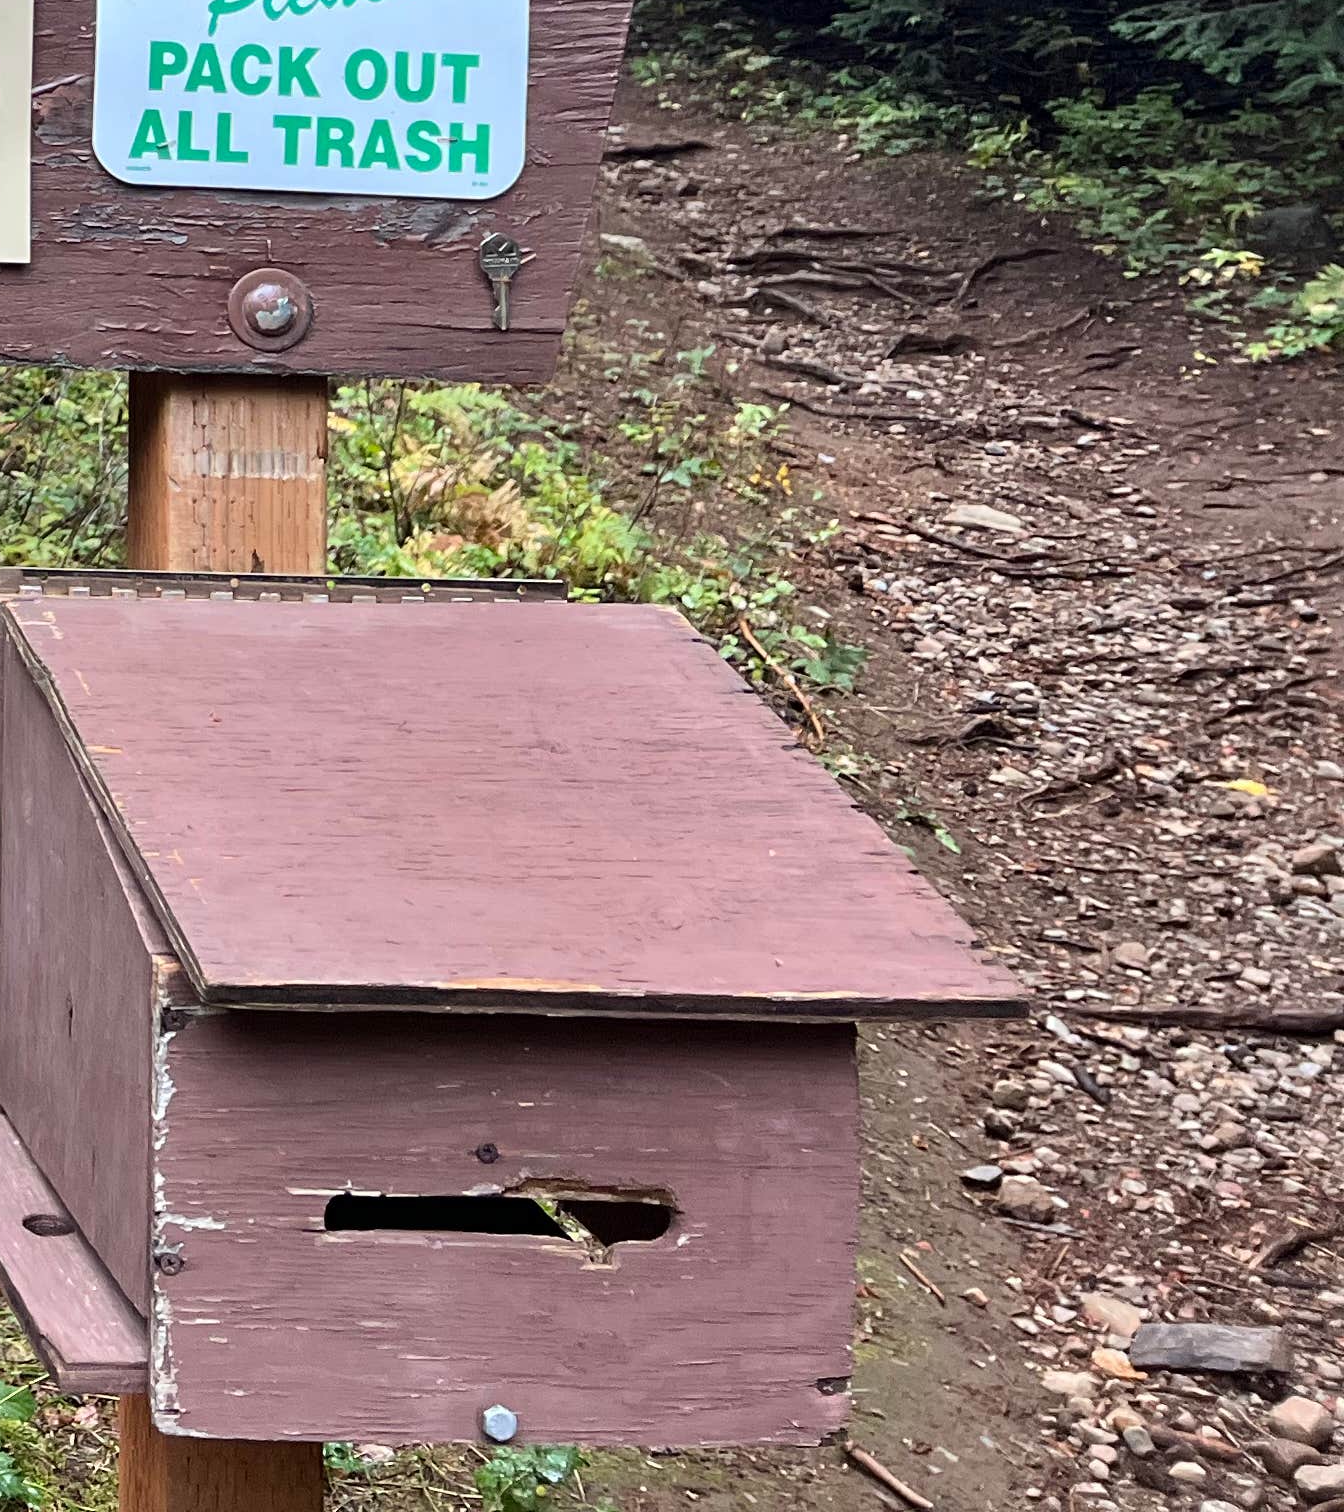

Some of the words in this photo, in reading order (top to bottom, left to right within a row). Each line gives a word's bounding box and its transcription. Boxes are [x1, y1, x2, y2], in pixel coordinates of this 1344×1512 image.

[148, 40, 320, 97] PACK
[344, 48, 480, 103] OUT
[128, 108, 248, 163] ALL
[272, 114, 490, 174] TRASH
